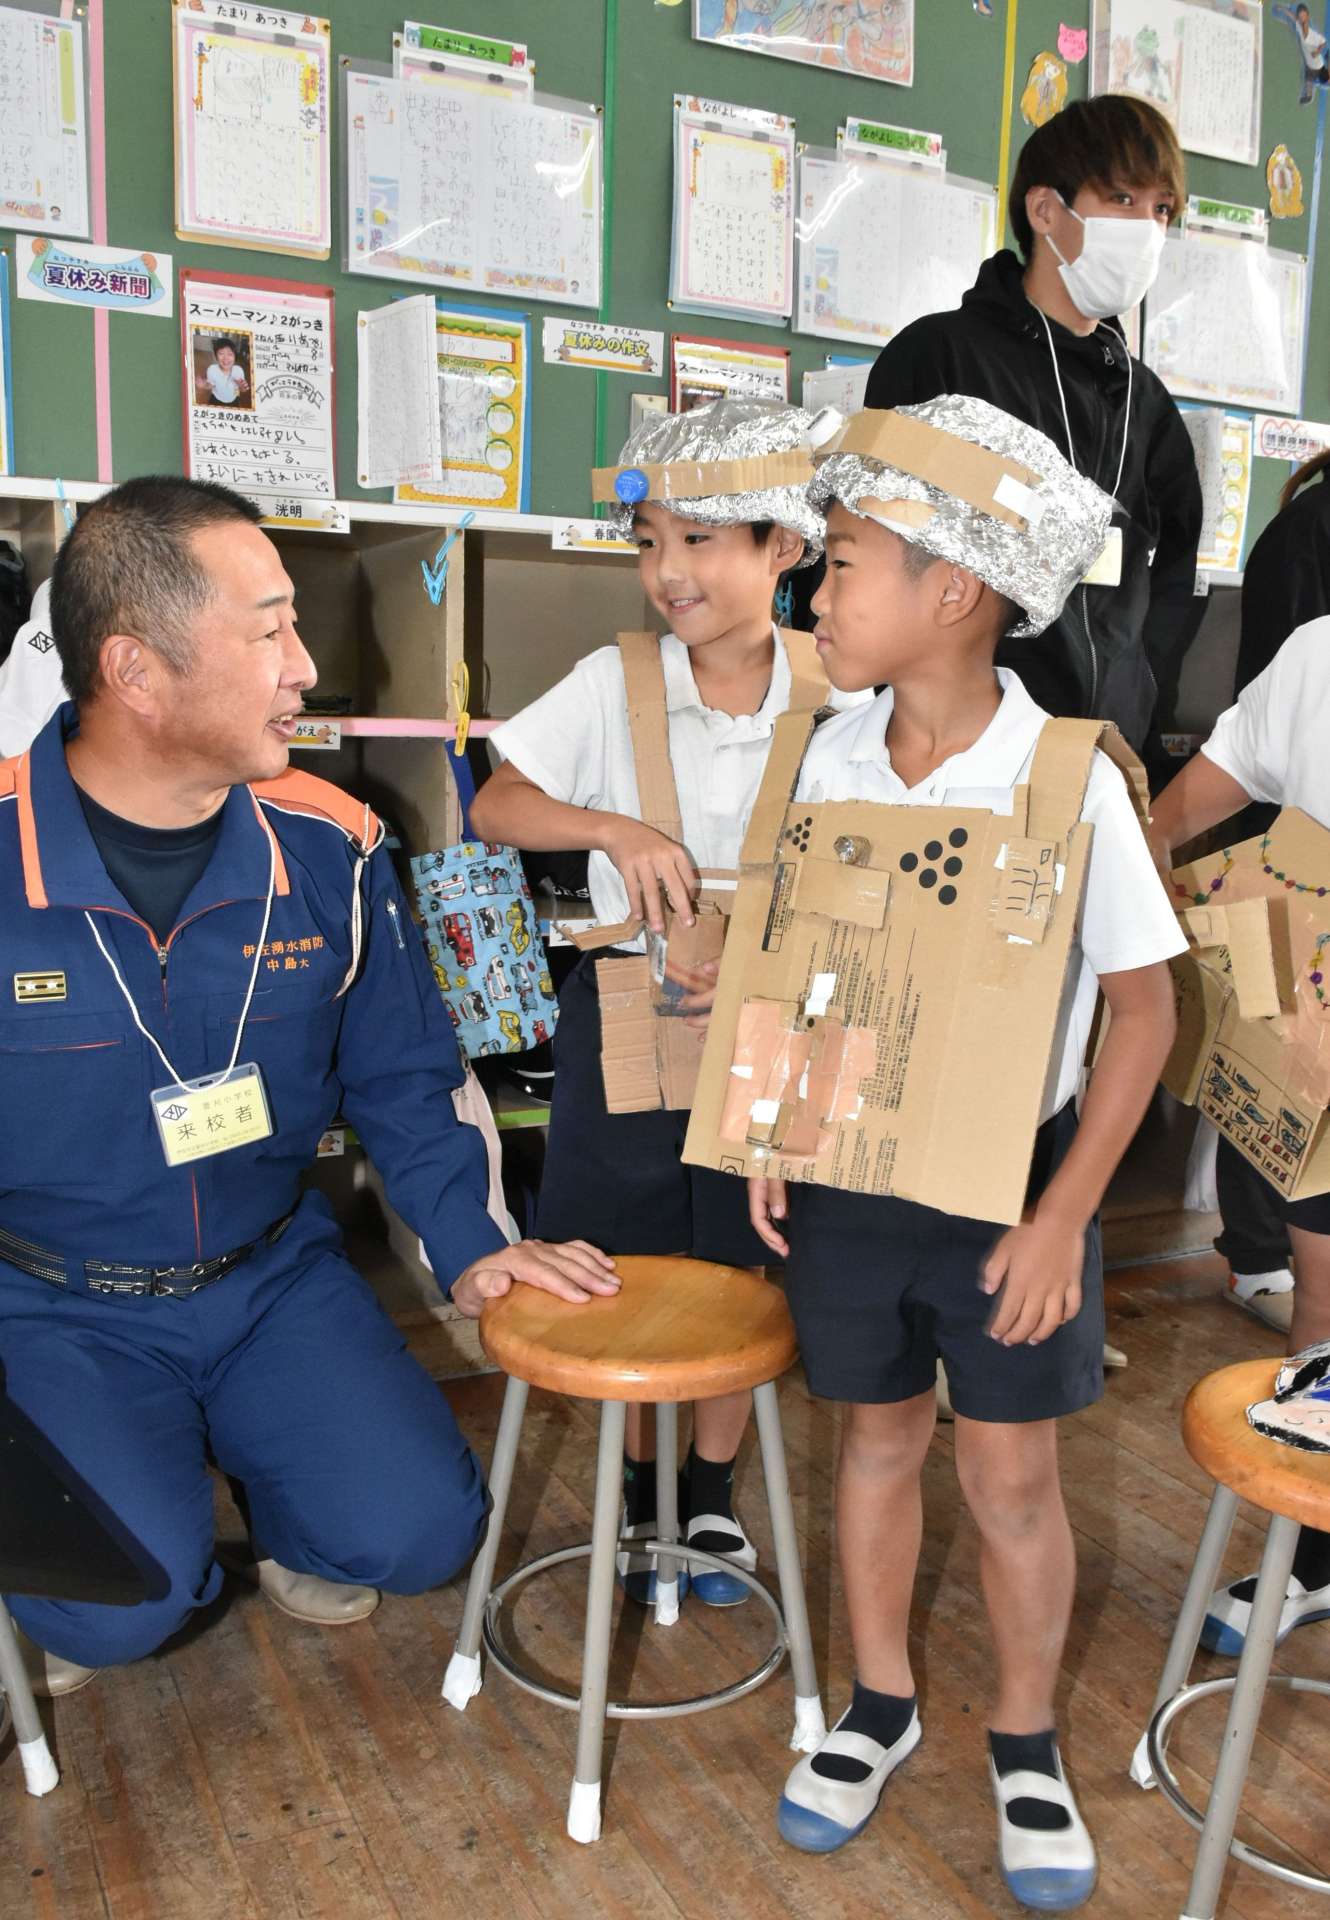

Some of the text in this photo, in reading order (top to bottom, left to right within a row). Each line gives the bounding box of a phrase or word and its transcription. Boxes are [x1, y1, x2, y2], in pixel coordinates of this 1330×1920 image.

[216, 4, 290, 28] たまり あつき
[45, 263, 149, 297] 夏休み新聞
[563, 329, 651, 357] 夏休みの作文
[193, 409, 259, 424] 2がっきのめあて
[176, 1102, 255, 1143] 来校者
